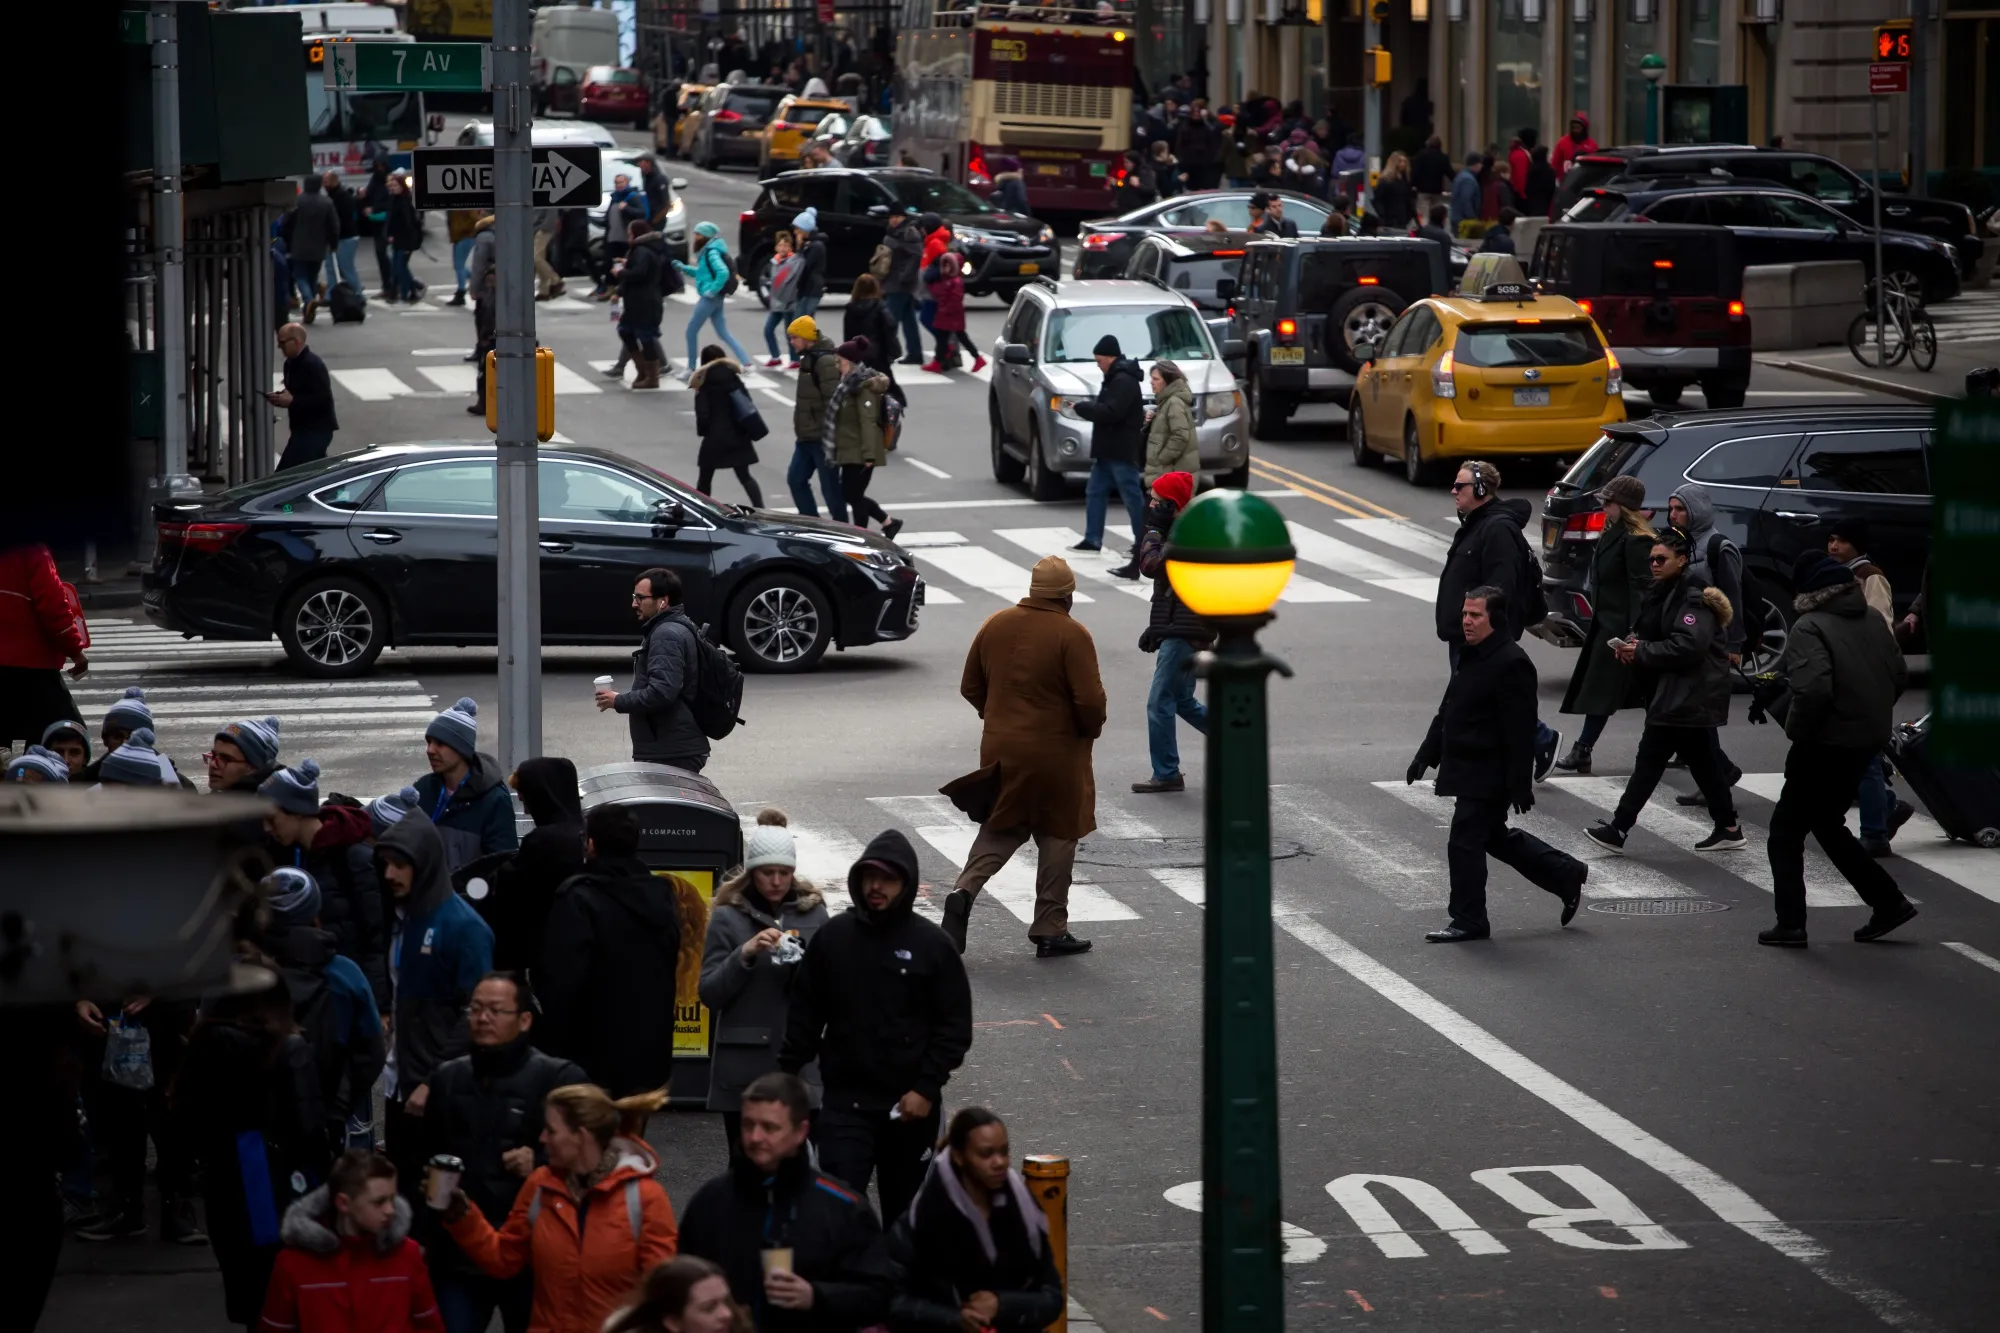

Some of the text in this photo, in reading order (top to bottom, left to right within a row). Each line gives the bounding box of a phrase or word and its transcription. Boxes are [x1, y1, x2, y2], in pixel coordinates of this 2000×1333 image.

[391, 50, 407, 84] 7
[441, 165, 573, 191] ONE AY
[1497, 285, 1520, 293] 5G92
[649, 828, 697, 836] COMPACTOR
